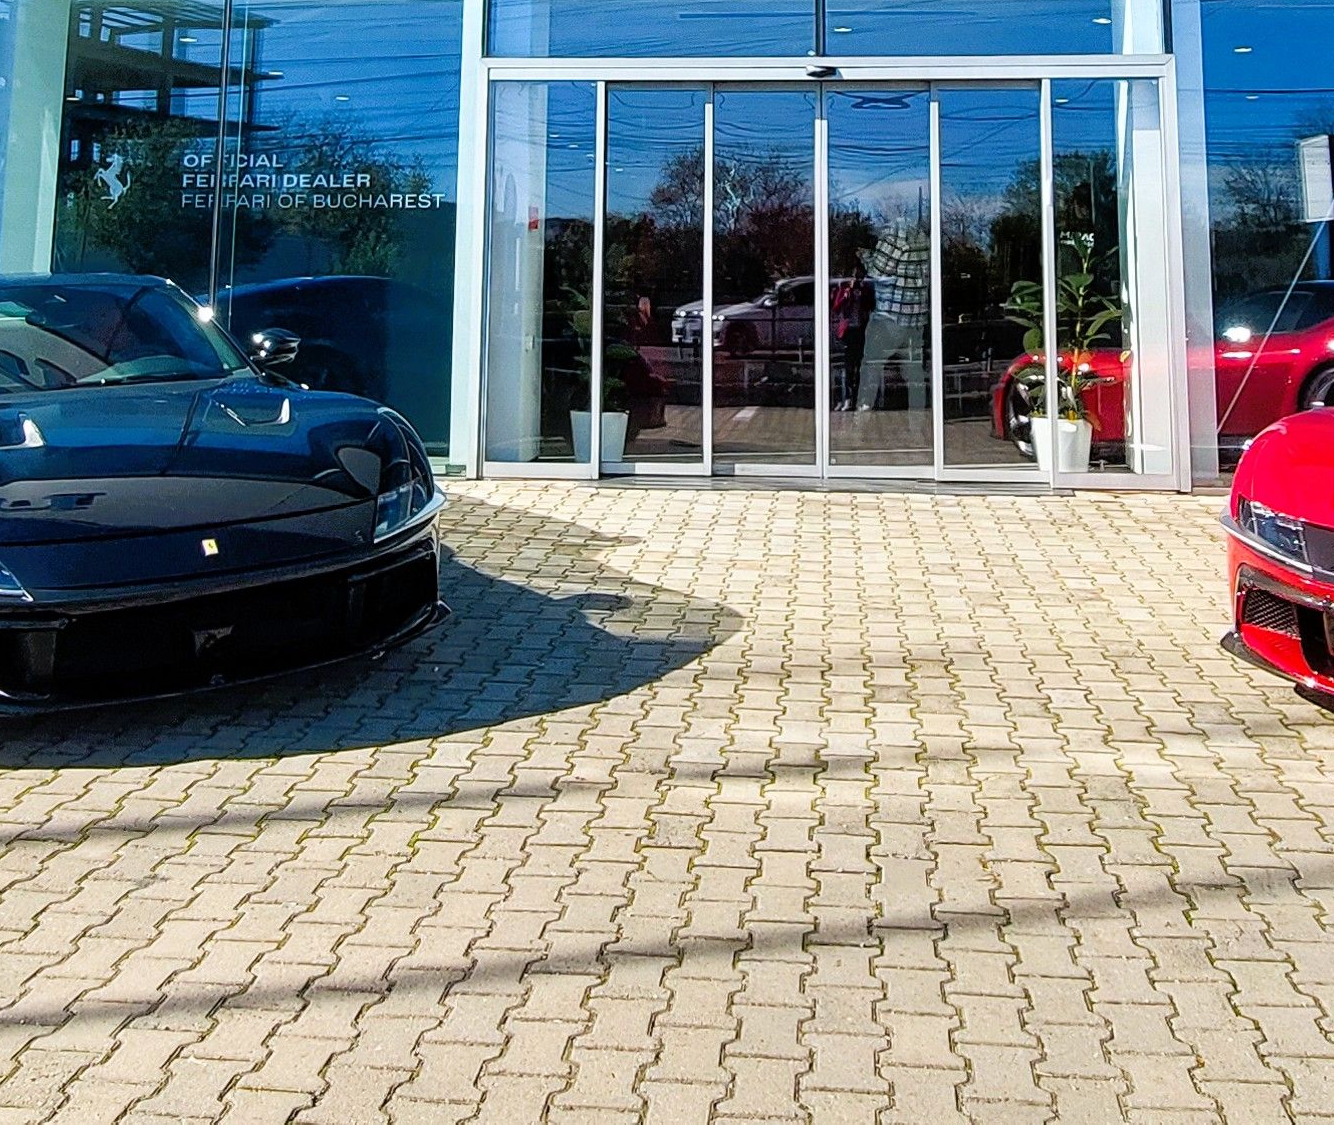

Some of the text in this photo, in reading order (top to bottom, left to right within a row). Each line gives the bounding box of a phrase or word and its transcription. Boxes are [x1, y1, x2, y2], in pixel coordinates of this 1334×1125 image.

[283, 173, 371, 188] DEALER
[278, 193, 307, 209] OF
[313, 193, 446, 209] BUCHAREST
